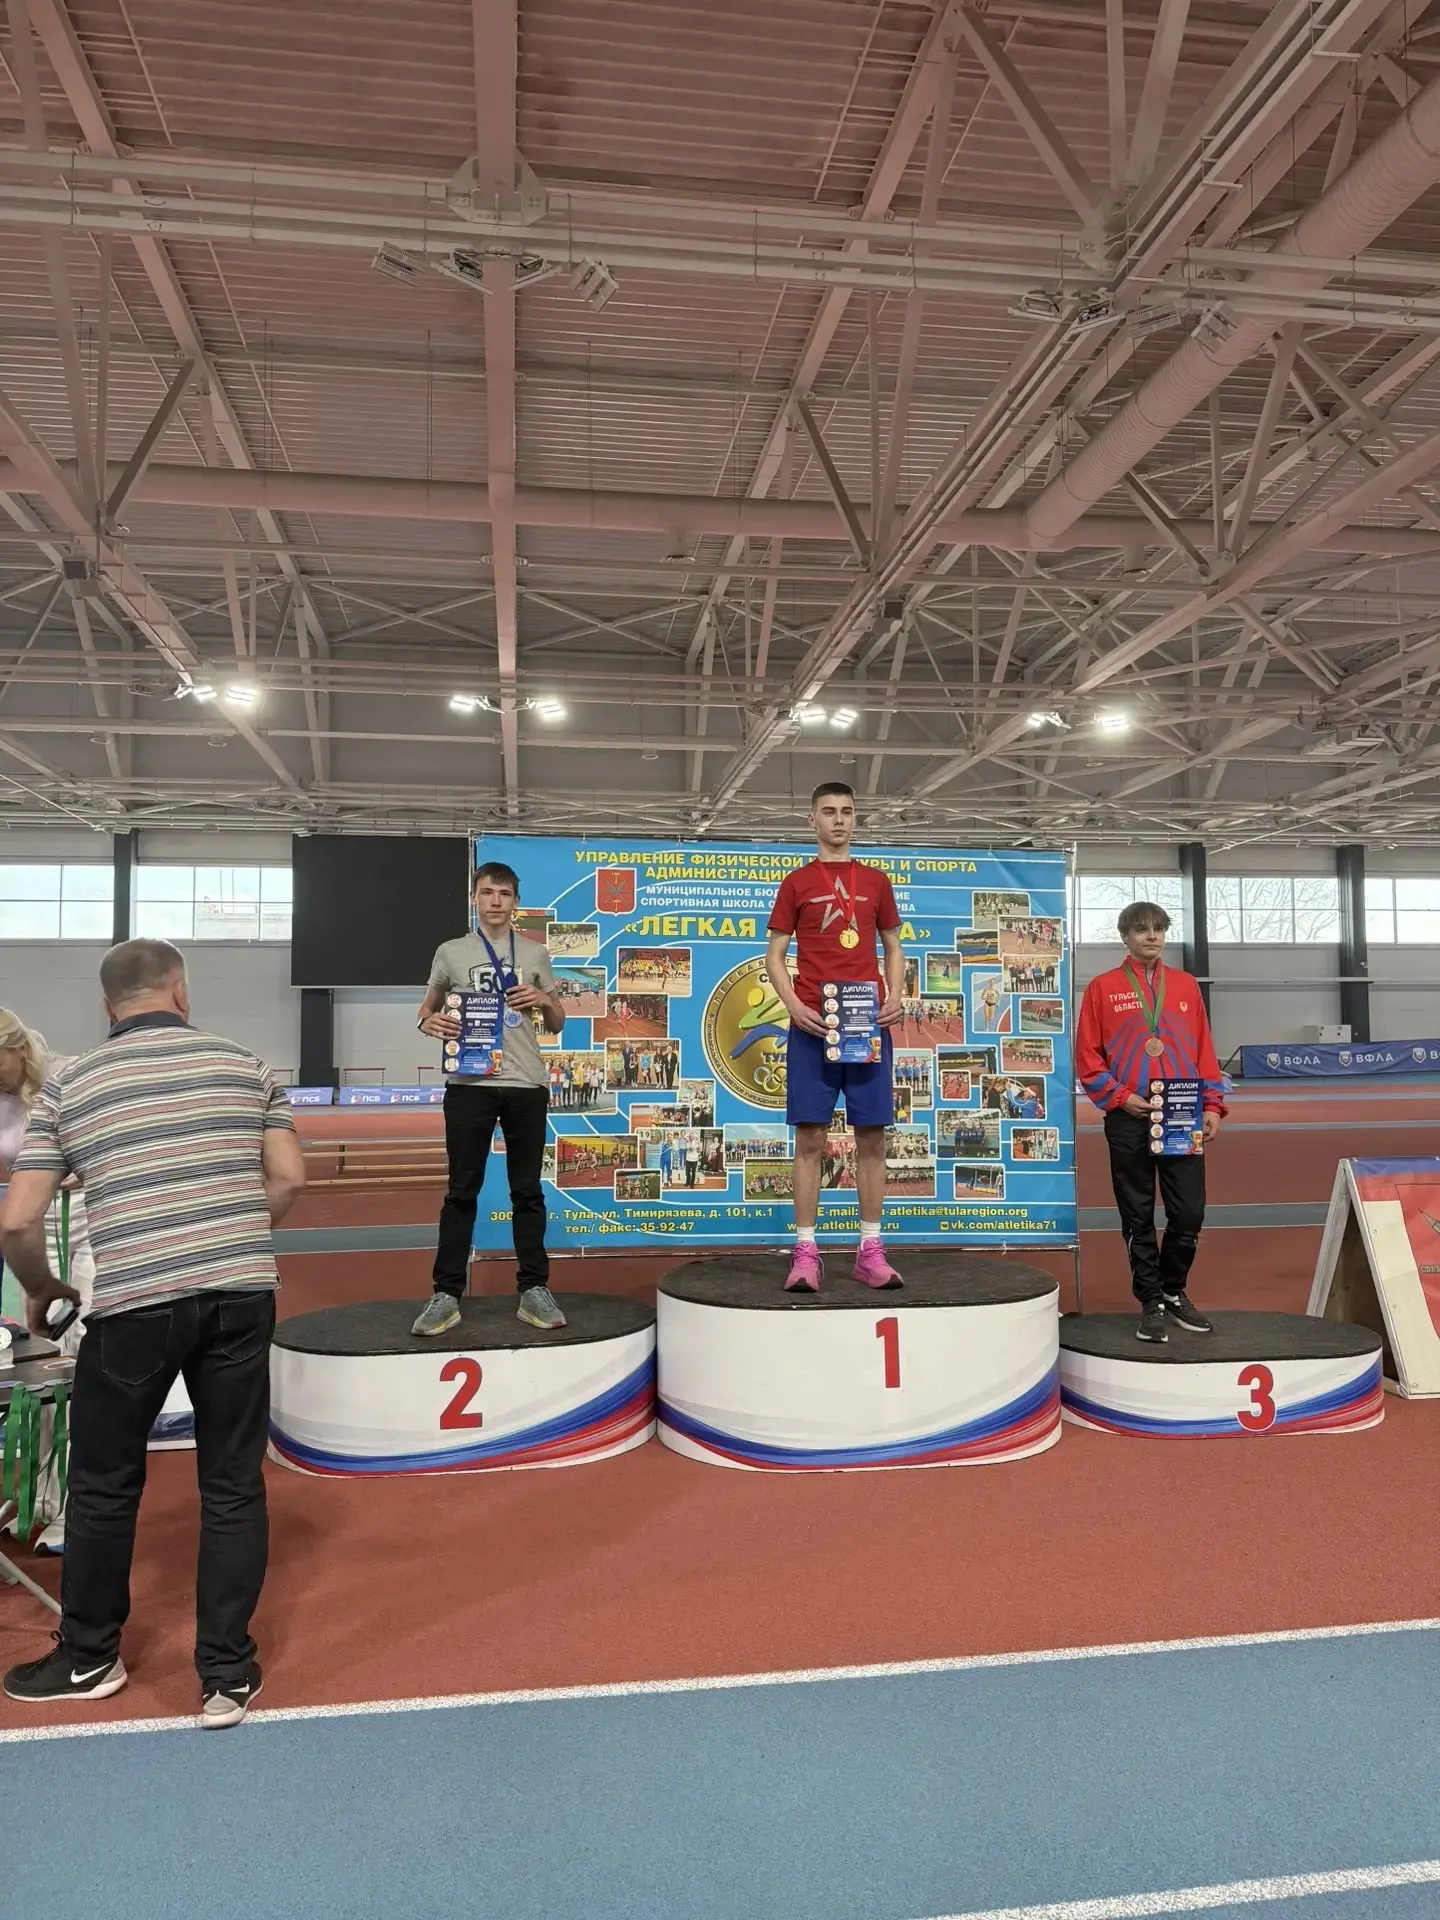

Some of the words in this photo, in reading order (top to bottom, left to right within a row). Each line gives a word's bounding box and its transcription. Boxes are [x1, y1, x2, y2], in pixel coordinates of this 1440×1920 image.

[574, 851, 685, 864] УПРАВЛЕНИЕ
[690, 853, 803, 868] ФИЗИЧЕСКОЙ
[900, 860, 911, 870] И
[915, 860, 977, 872] СПОРТА
[646, 886, 751, 896] МУНИЦИПАЛЬНОЕ
[640, 897, 719, 908] СПОРТИВНАЯ
[722, 899, 765, 908] ШКОЛА
[466, 997, 499, 1005] ДИПЛОМ
[1109, 991, 1140, 1003] ТУЛЬСК
[549, 1212, 559, 1220] г.
[563, 1209, 598, 1220] Тула,
[602, 1210, 620, 1220] ул.
[624, 1208, 706, 1219] Тимирязева,
[709, 1209, 721, 1218] д.
[725, 1207, 752, 1218] 101,
[755, 1207, 773, 1217] к.1
[817, 1206, 859, 1216] E-mail:
[880, 1206, 1028, 1218] a-atletika@tularegion.org
[598, 1222, 636, 1234] факс:
[640, 1221, 695, 1232] 35-92-47
[951, 1220, 1057, 1230] vk.com/atletika71
[876, 1317, 901, 1388] 1
[439, 1357, 483, 1430] 2
[1237, 1364, 1276, 1431] 3
